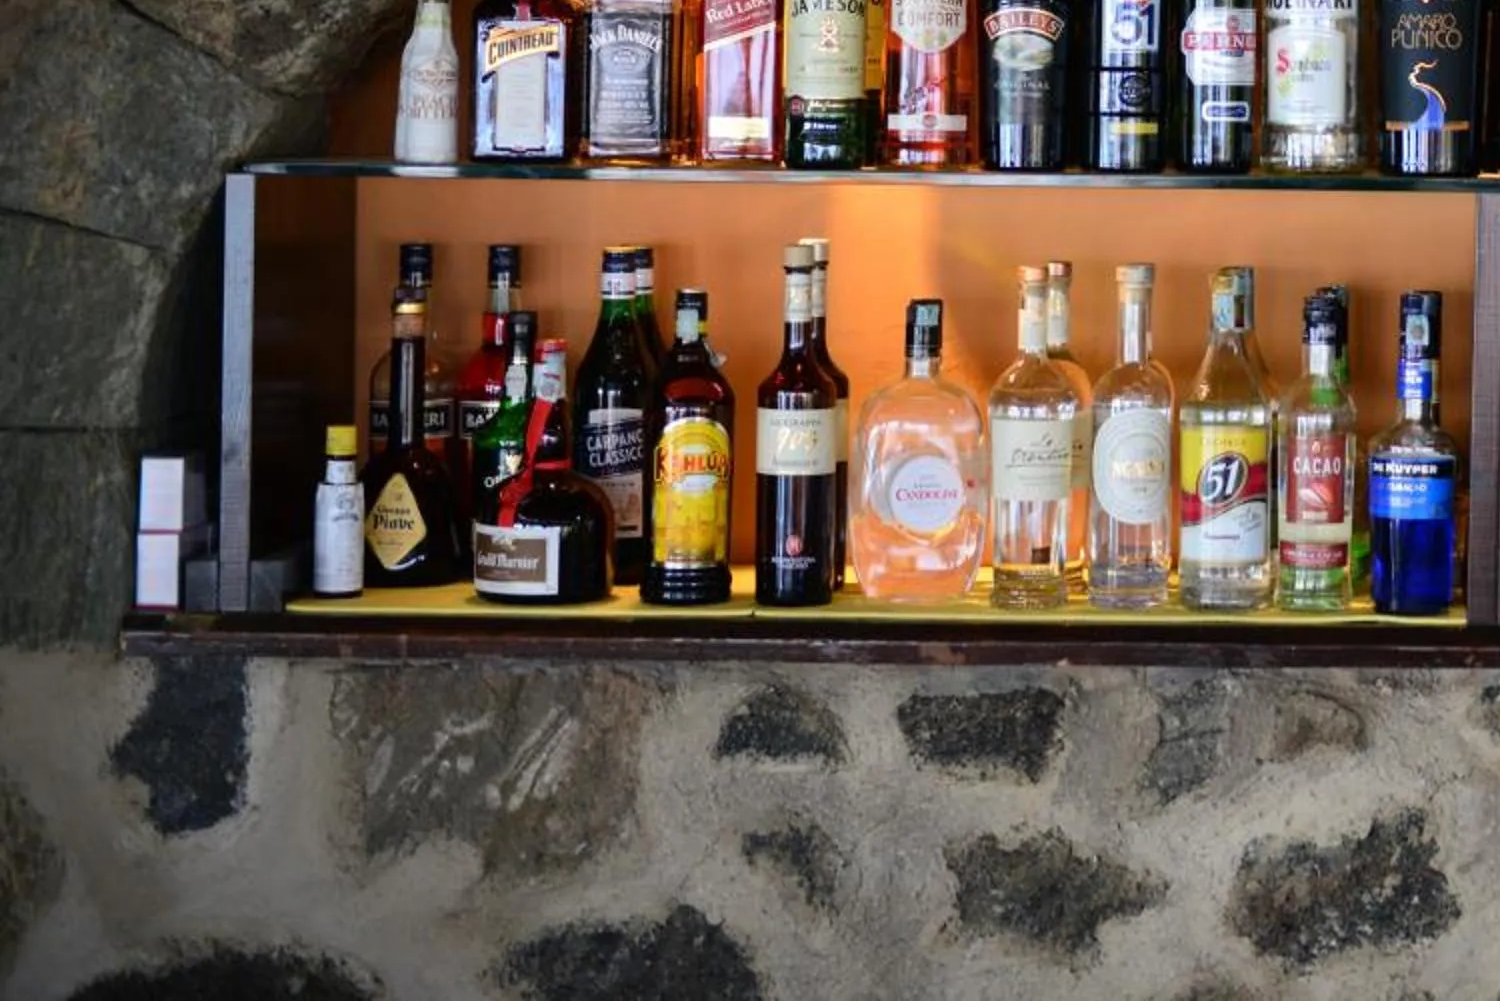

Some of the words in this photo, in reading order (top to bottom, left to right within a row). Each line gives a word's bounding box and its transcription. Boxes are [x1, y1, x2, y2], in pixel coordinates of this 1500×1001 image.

[706, 5, 733, 24] Red
[897, 11, 961, 28] COMFORT
[989, 11, 1058, 35] BAILEYS
[1111, 2, 1155, 46] 51
[489, 29, 554, 66] COINTREAU
[1391, 28, 1463, 49] PUNICO
[1292, 456, 1341, 475] CACAO
[1205, 459, 1241, 503] 51
[373, 513, 416, 531] Piave
